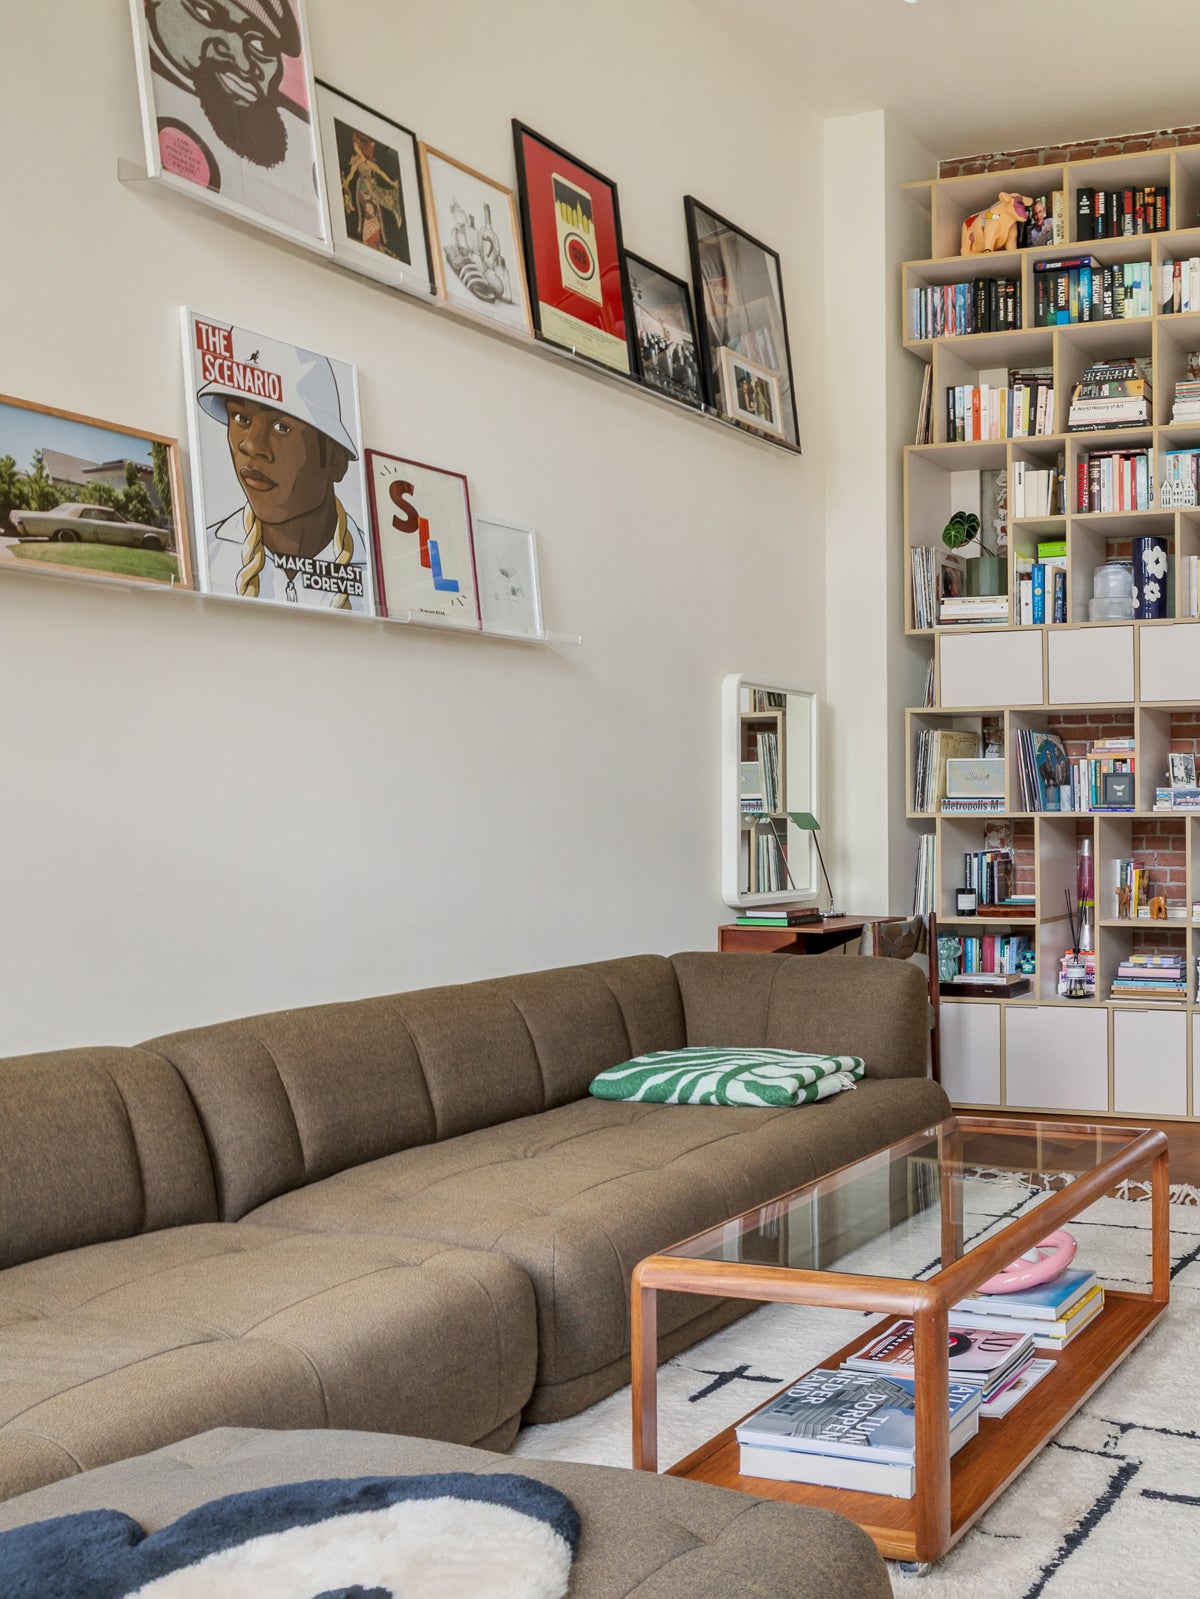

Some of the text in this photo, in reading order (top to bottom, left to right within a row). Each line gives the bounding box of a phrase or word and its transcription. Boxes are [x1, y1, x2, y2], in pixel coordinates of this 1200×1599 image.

[1057, 278, 1065, 306] STALKER
[1092, 275, 1100, 304] SPIEGELMAN
[1103, 291, 1112, 315] SPIN
[1114, 287, 1125, 318] NACHT
[199, 322, 231, 358] THE
[204, 353, 280, 400] SCENARIO
[274, 553, 362, 581] MAKE IT LAST
[303, 574, 363, 596] FOREVER
[942, 800, 999, 811] Metropolis M
[787, 1369, 832, 1397] LAND
[801, 1371, 859, 1405] NEDER
[816, 1393, 888, 1443] DORPEN
[840, 1415, 890, 1444] TUIN
